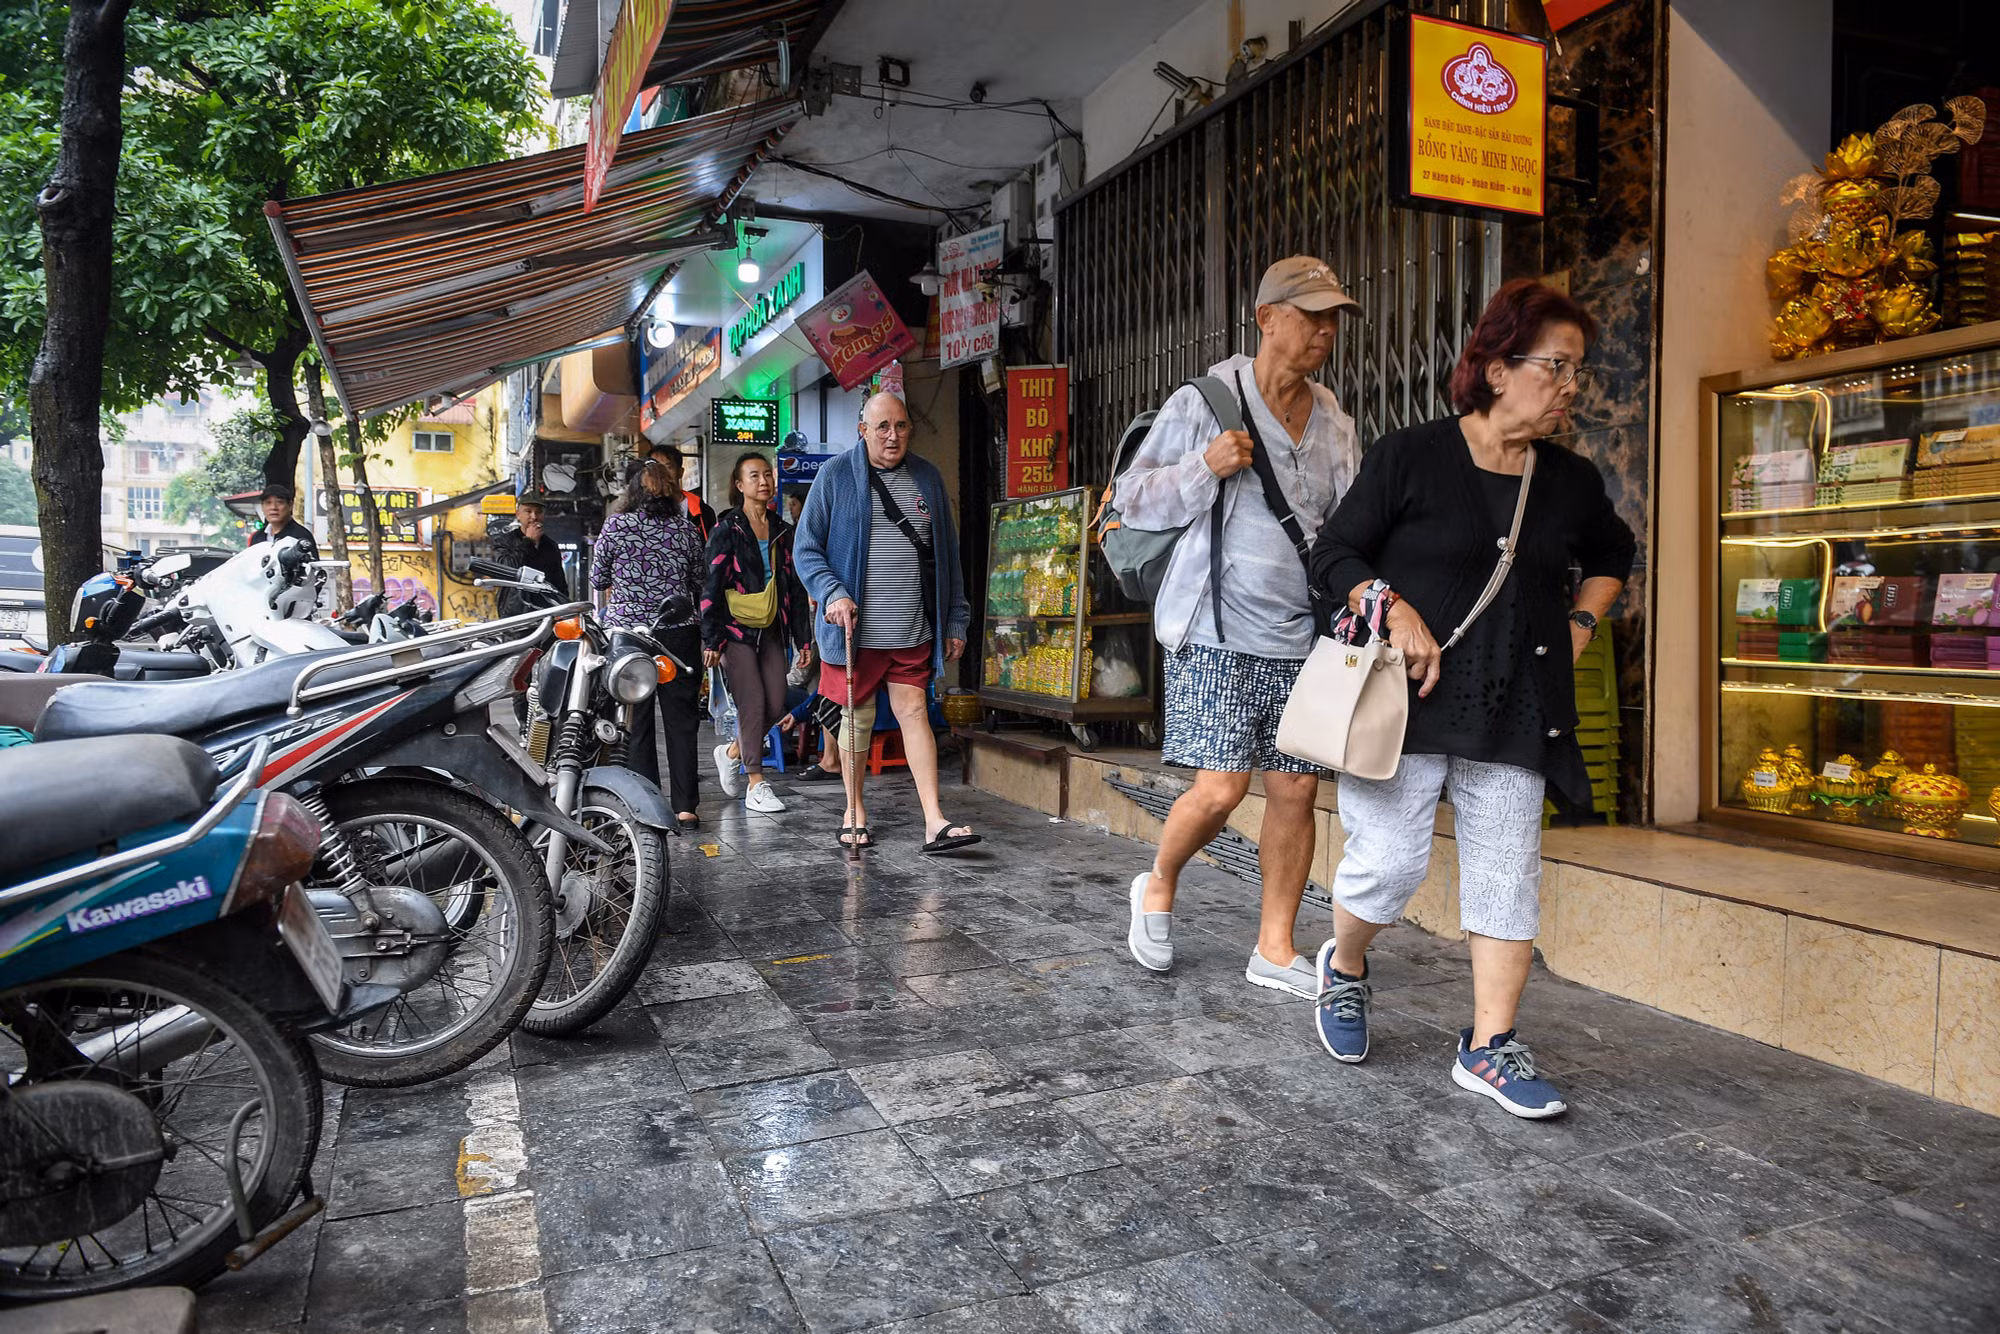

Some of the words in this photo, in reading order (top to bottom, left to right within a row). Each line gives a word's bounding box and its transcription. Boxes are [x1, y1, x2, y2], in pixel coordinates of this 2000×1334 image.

[1450, 140, 1478, 165] VÀNG
[1481, 149, 1507, 171] MINH
[1511, 155, 1538, 179] NGỌC
[1422, 170, 1431, 180] 27
[728, 317, 746, 357] TẠP
[768, 261, 804, 321] XANH
[1020, 378, 1055, 402] THỊT
[725, 417, 765, 432] XANH
[1026, 403, 1049, 428] BÒ
[737, 431, 753, 440] 24H
[1020, 433, 1055, 458] KHÔ
[1022, 465, 1054, 483] 25B
[66, 875, 212, 933] Kawasaki
